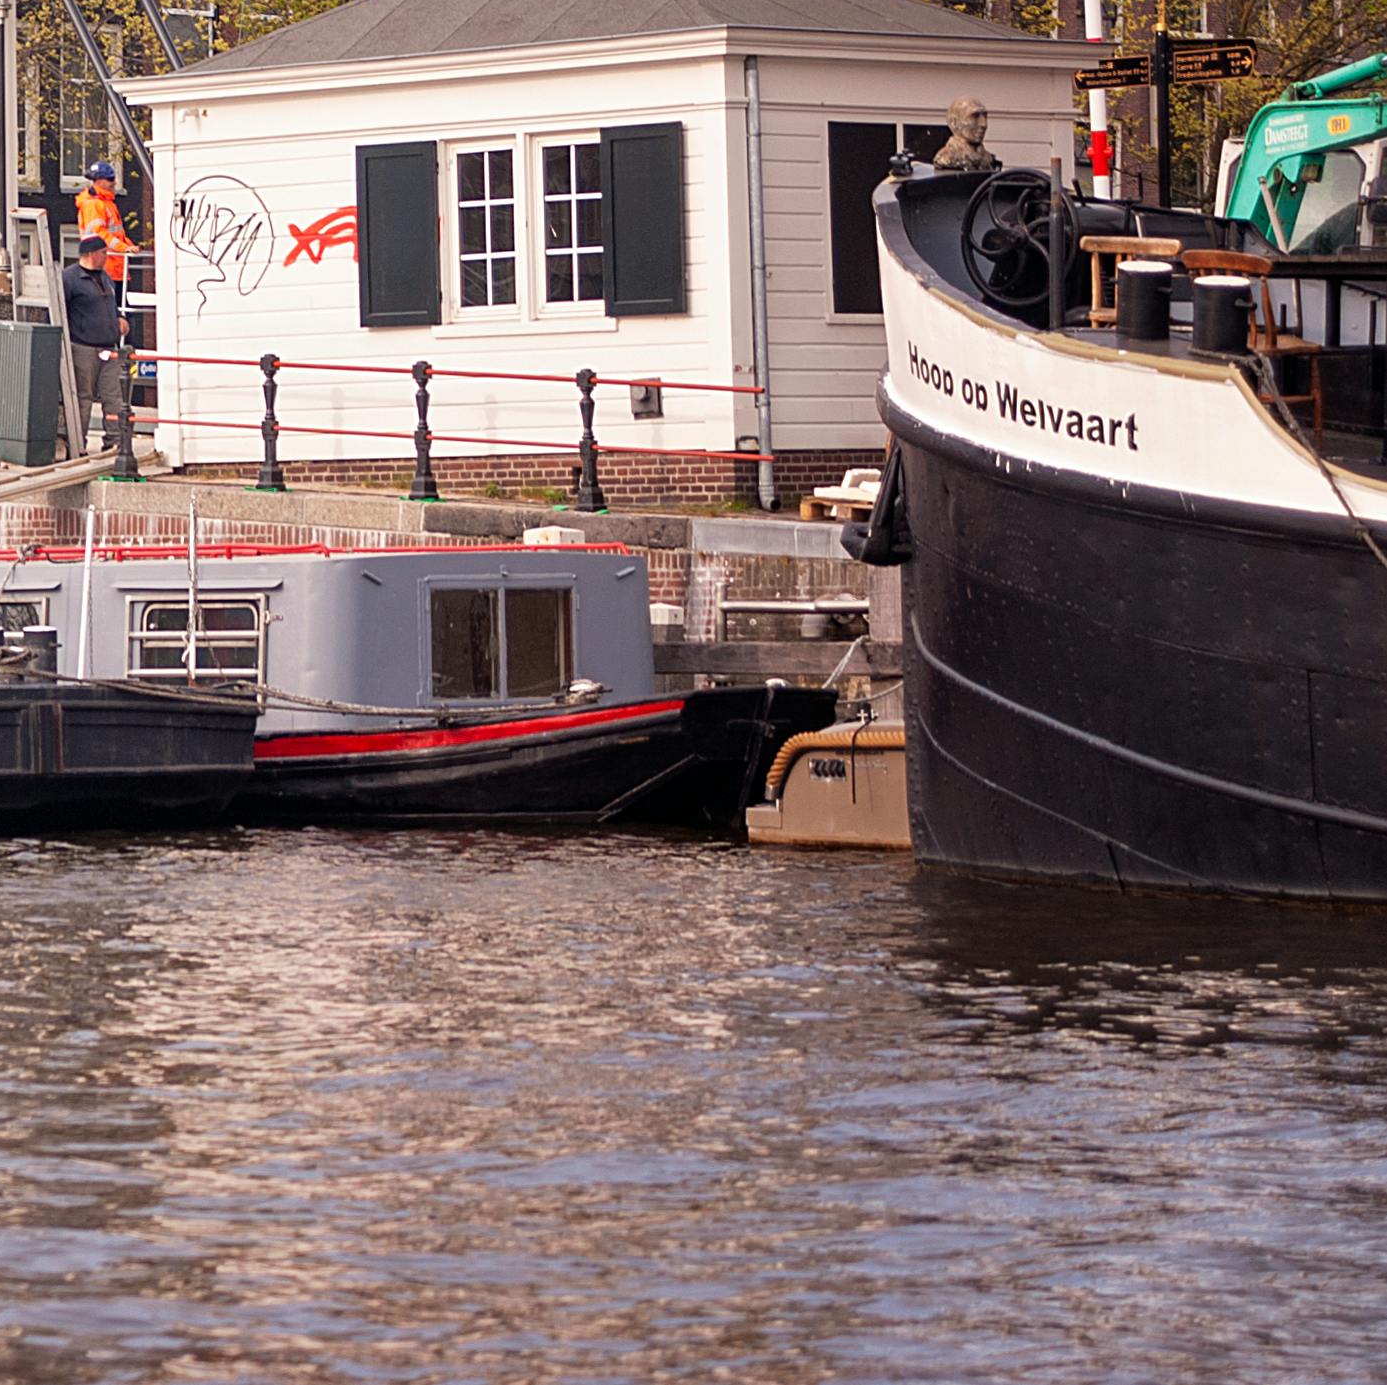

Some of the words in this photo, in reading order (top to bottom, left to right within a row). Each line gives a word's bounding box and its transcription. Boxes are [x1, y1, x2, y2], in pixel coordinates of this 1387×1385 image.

[908, 340, 954, 398] Hoop
[962, 377, 988, 411] op
[996, 380, 1139, 451] Welvaart
